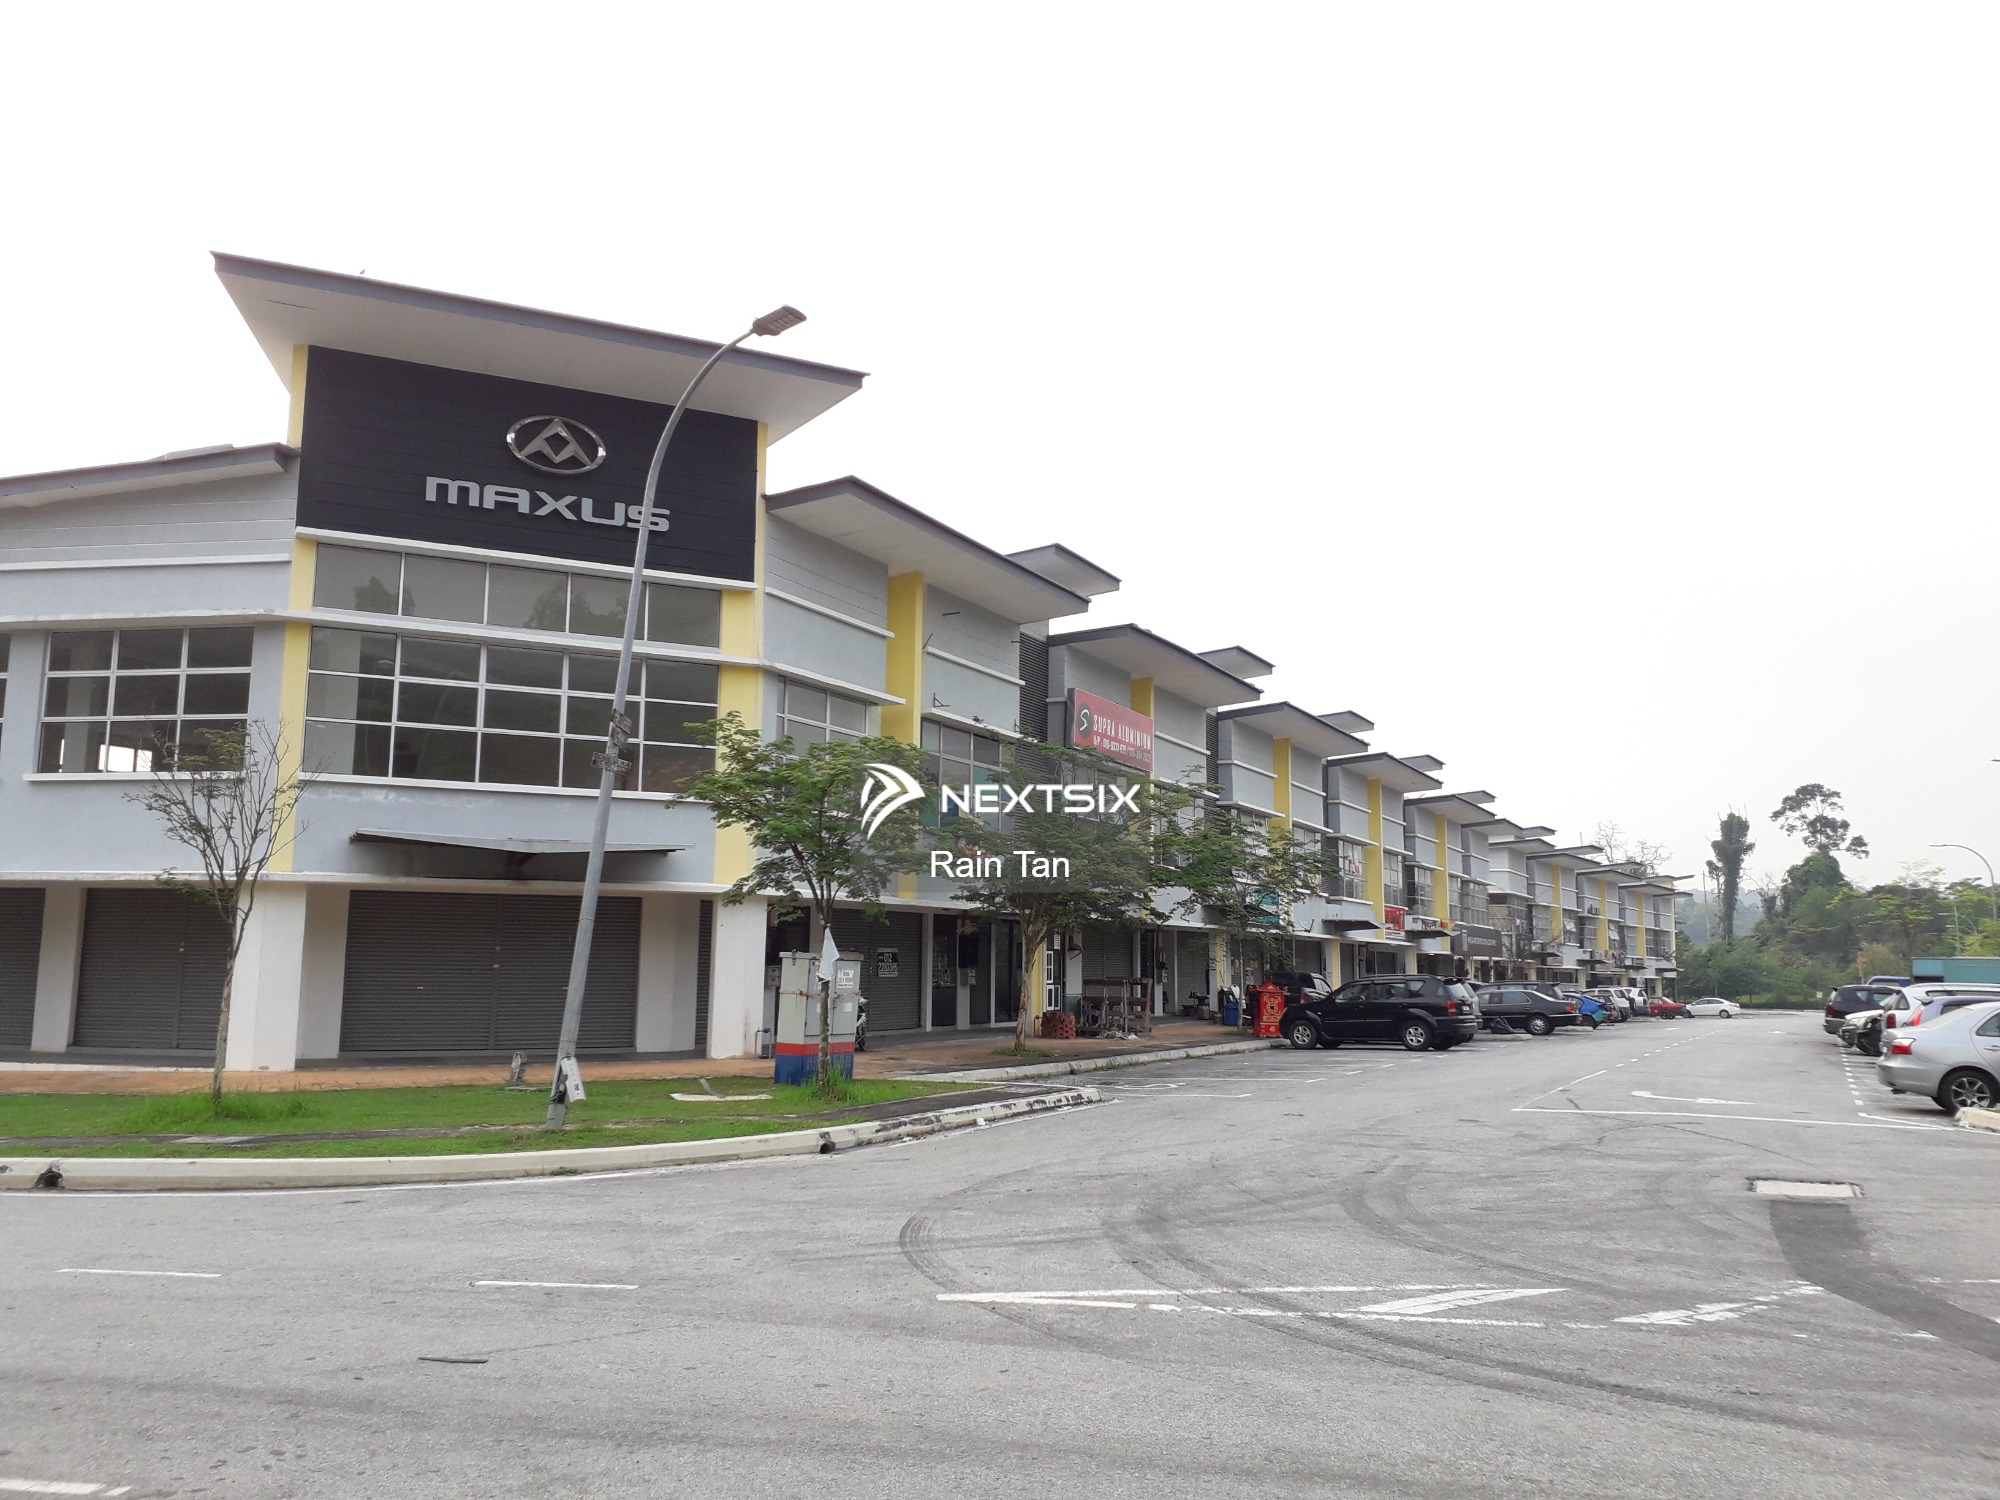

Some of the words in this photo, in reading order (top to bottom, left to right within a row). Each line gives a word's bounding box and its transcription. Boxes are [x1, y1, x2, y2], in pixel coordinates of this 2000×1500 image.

[425, 476, 671, 532] MAXUS
[1093, 714, 1116, 738] SUPRA
[1118, 723, 1152, 751] ALUMINIUM
